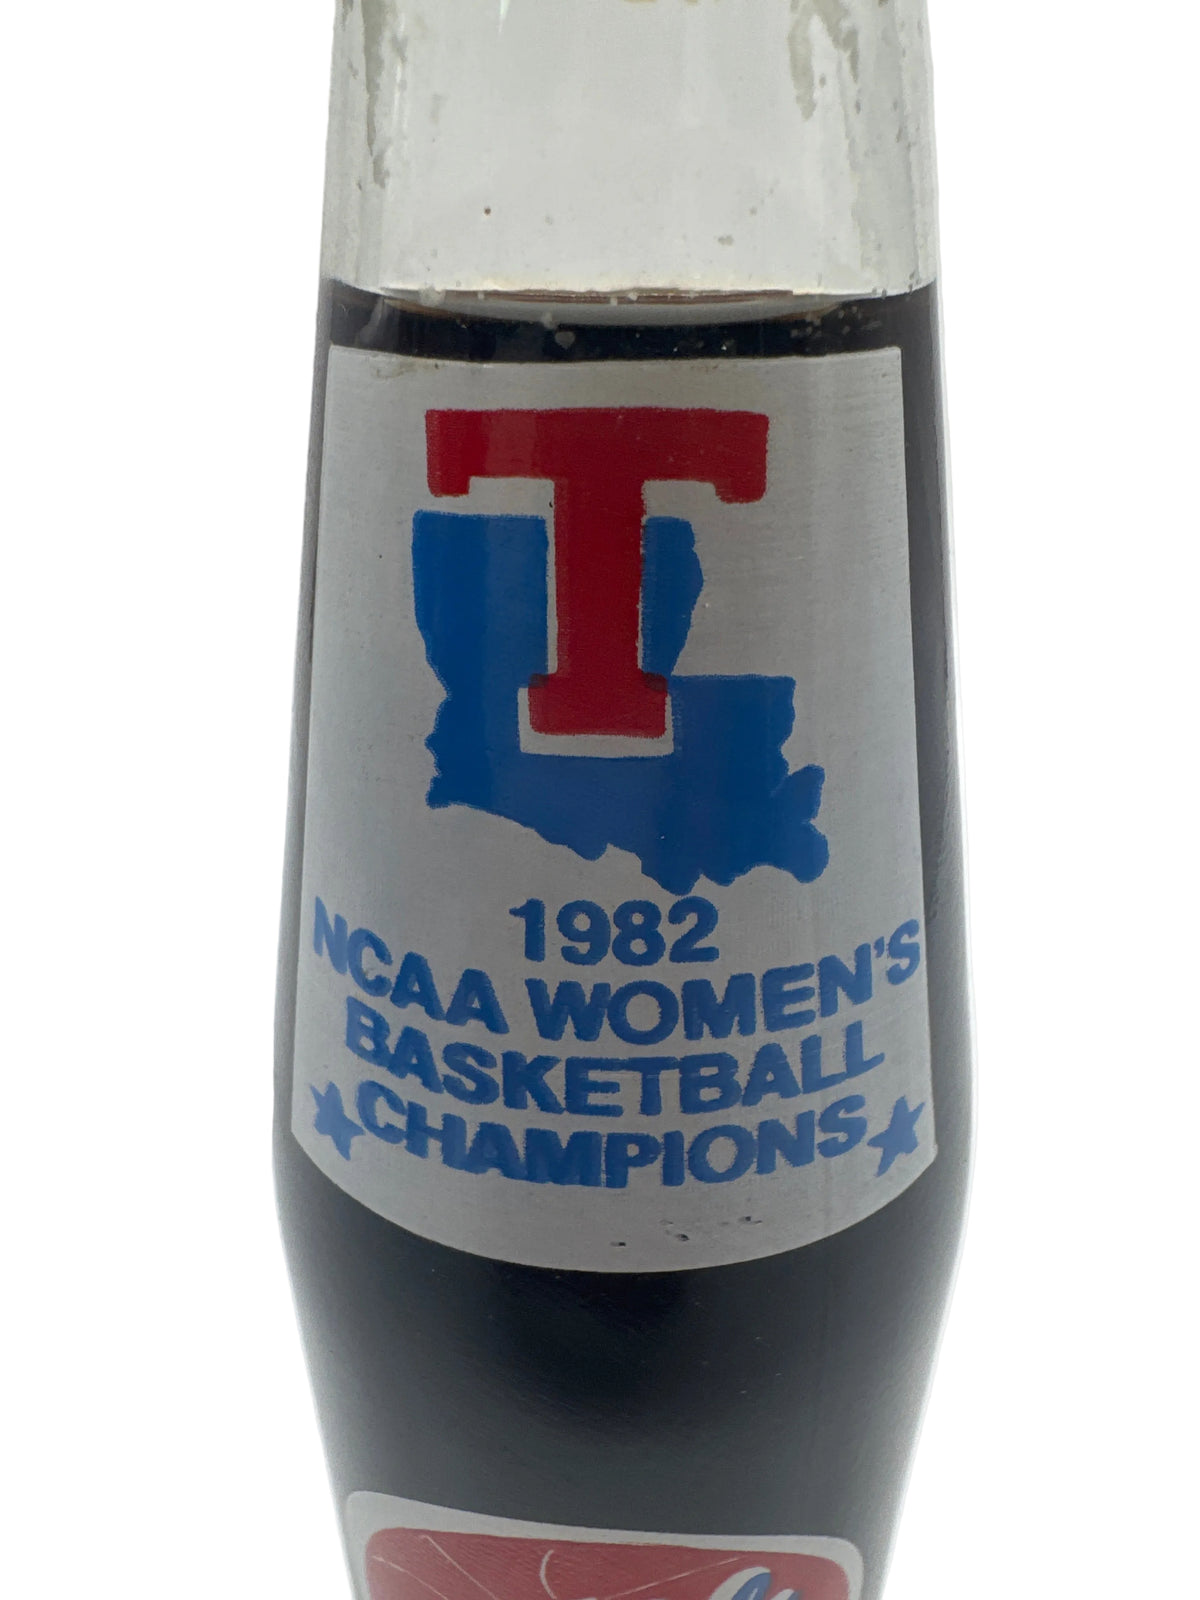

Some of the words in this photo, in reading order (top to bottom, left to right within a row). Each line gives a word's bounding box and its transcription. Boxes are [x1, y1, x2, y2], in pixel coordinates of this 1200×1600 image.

[425, 407, 769, 739] T
[312, 896, 508, 1035] NCAA
[525, 918, 921, 1045] WOMEN'S
[509, 896, 720, 966] 1982
[345, 995, 886, 1117] BASKETBALL
[355, 1079, 868, 1189] CHAMPIONS
